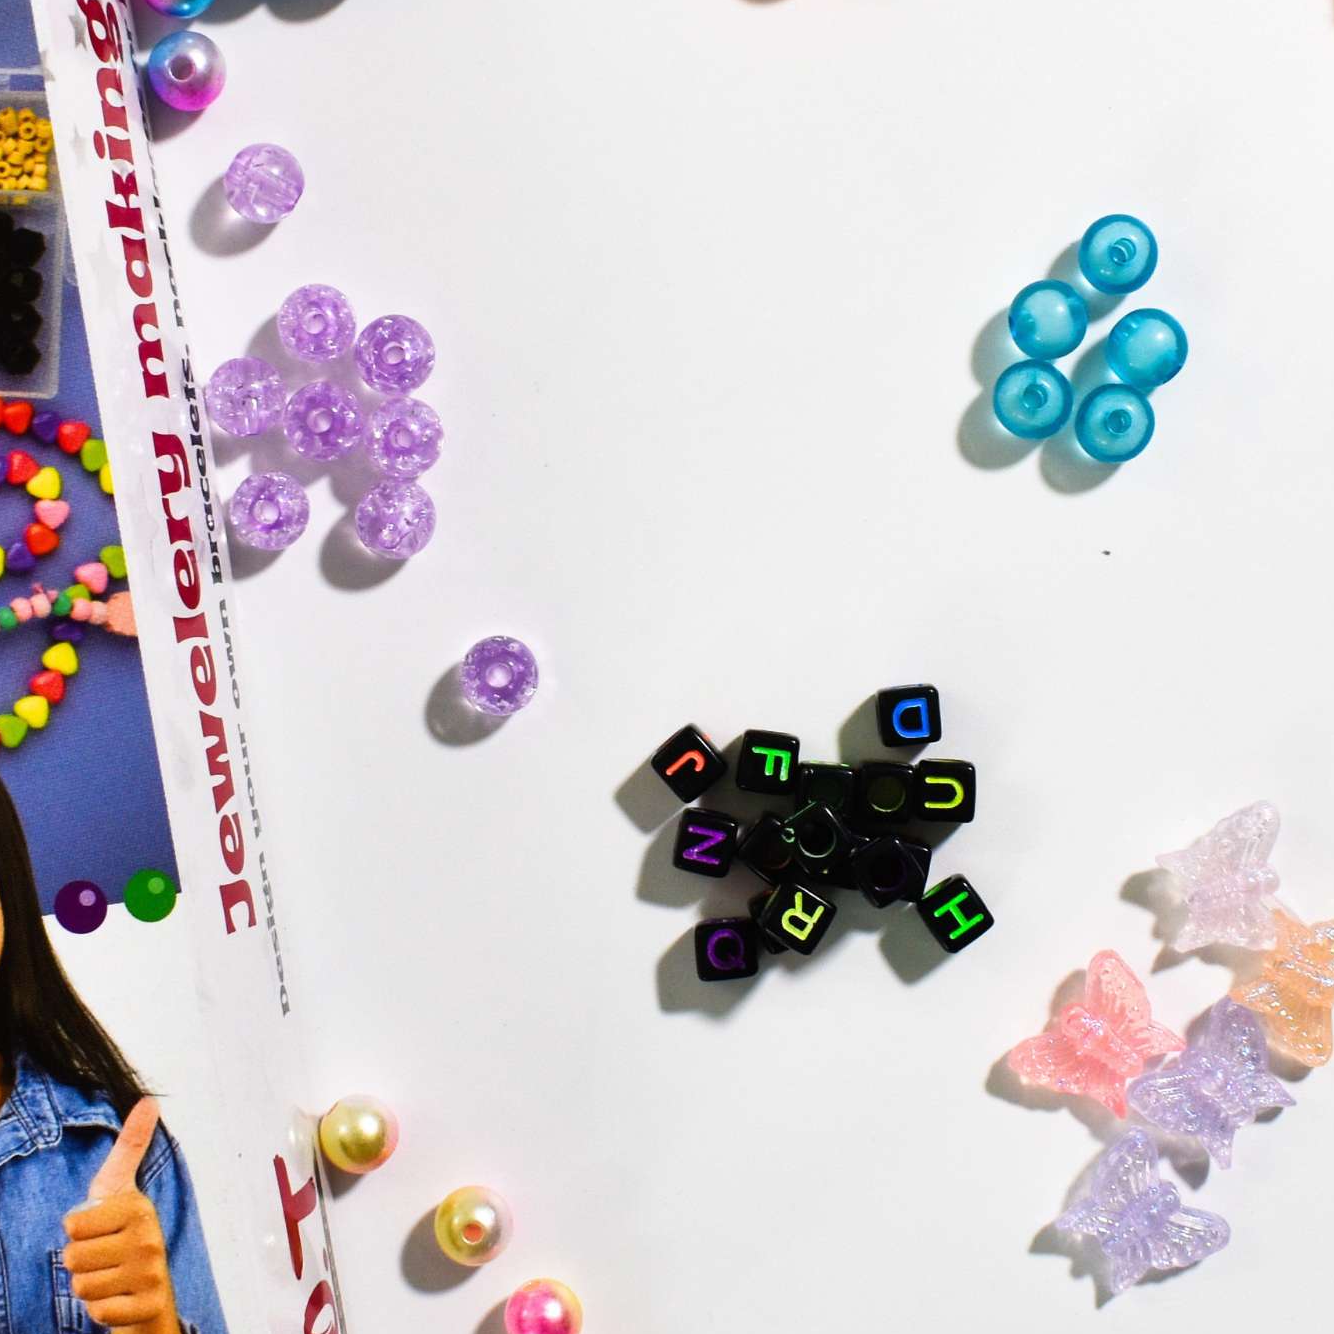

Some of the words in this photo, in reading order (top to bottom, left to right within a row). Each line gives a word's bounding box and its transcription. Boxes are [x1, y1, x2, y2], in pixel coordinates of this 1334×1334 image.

[219, 598, 241, 710] own
[152, 431, 257, 935] Jewelery
[892, 697, 931, 739] D
[237, 723, 262, 840] your
[665, 749, 706, 777] J
[751, 745, 792, 781] F
[781, 891, 825, 941] R
